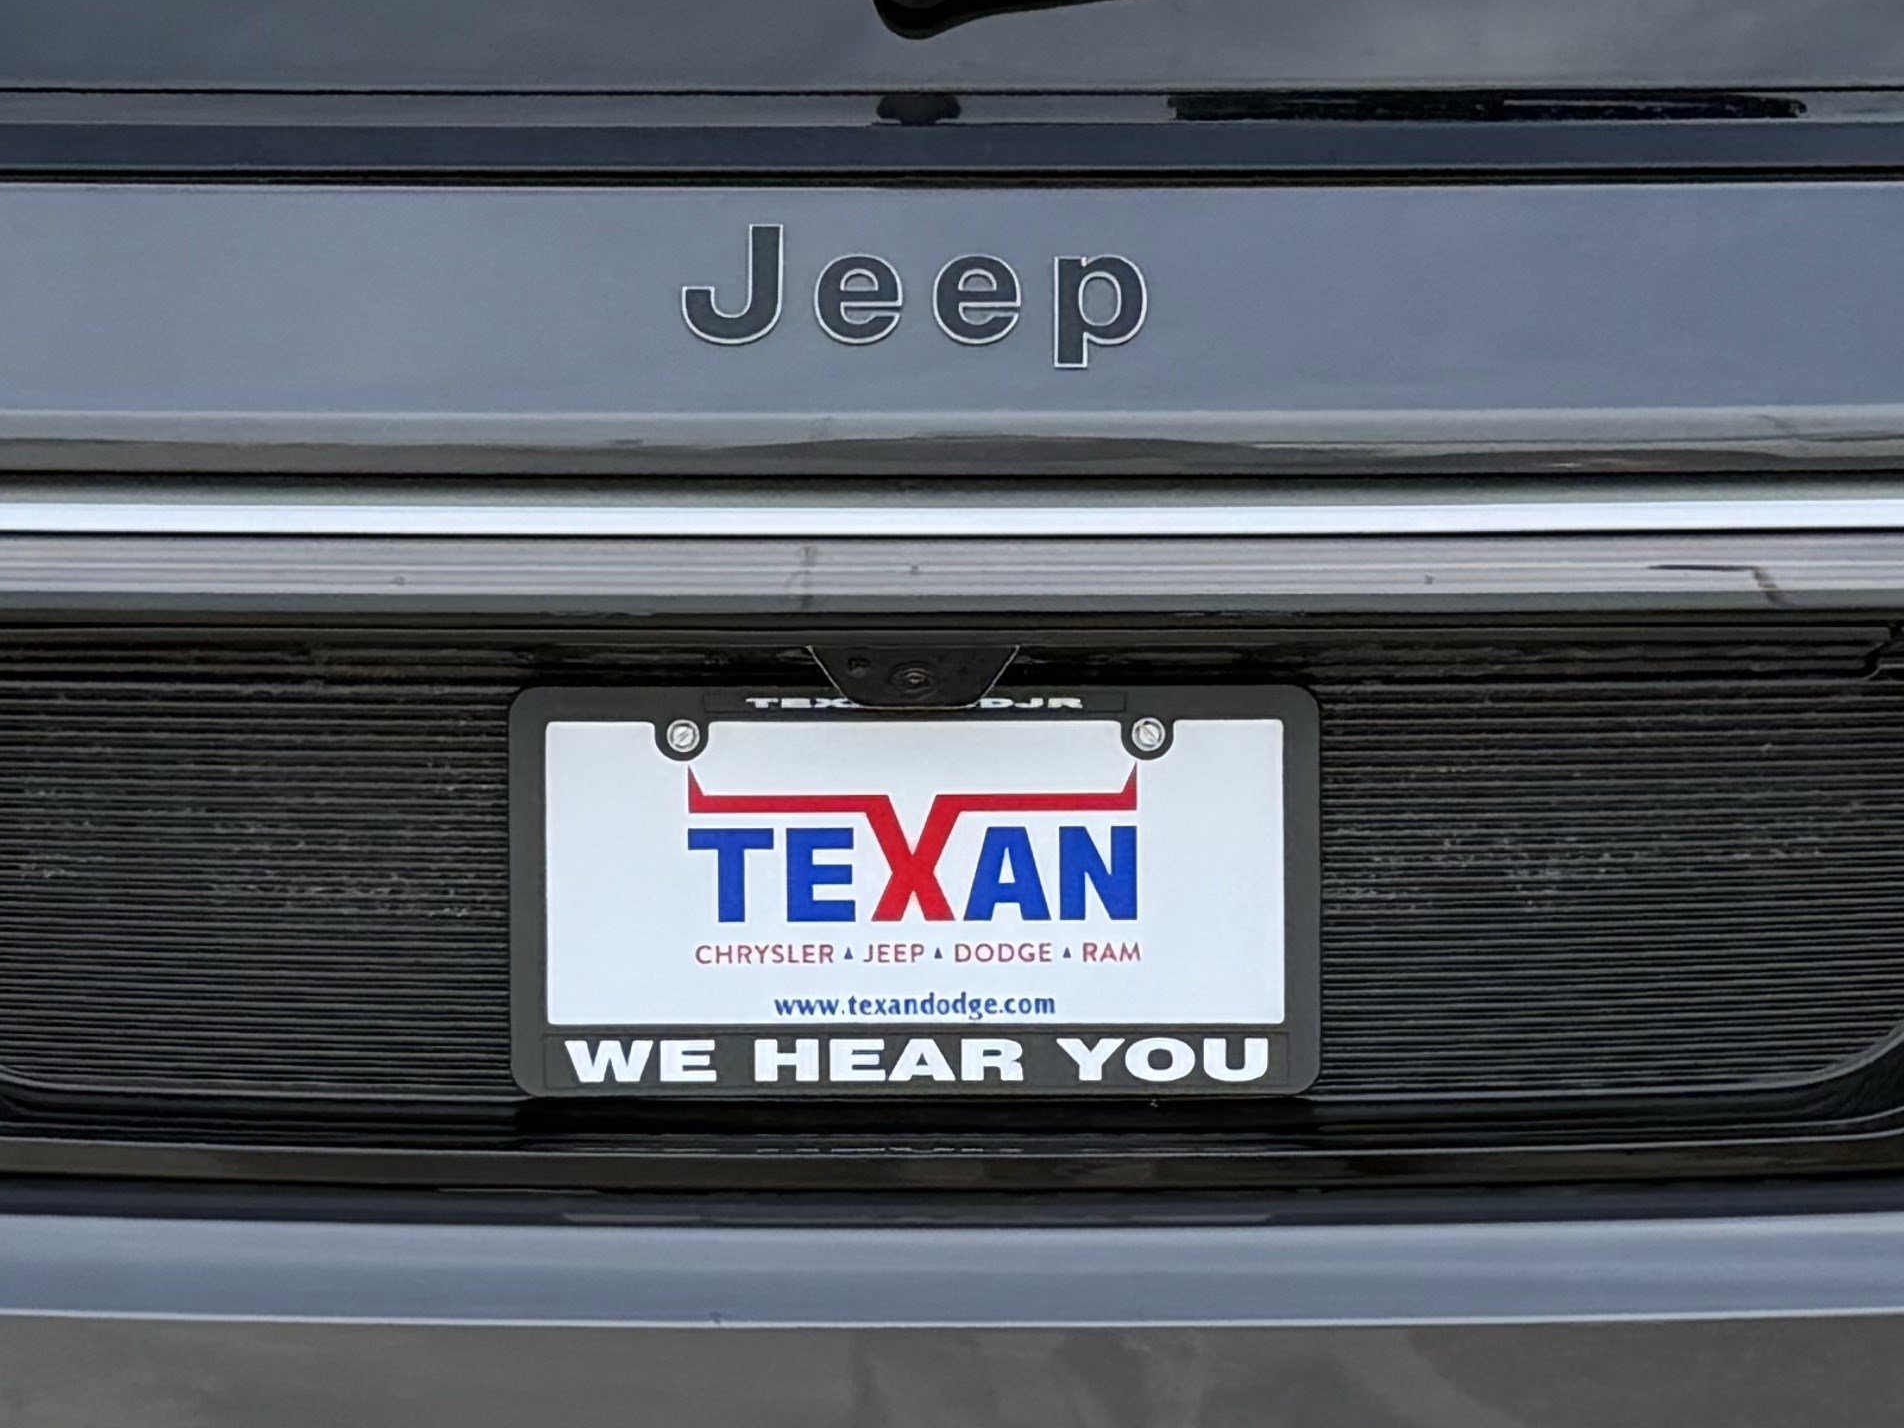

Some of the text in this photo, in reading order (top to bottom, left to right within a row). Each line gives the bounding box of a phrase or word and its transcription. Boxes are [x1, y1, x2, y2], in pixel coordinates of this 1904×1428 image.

[681, 222, 1149, 370] Jeep
[687, 784, 1139, 923] TEXAN
[694, 941, 1142, 965] CHRYSLER JEEP DODGE RAM
[774, 990, 1057, 1021] www.texandodge.com
[564, 1036, 1271, 1084] WE HEAR YOU
